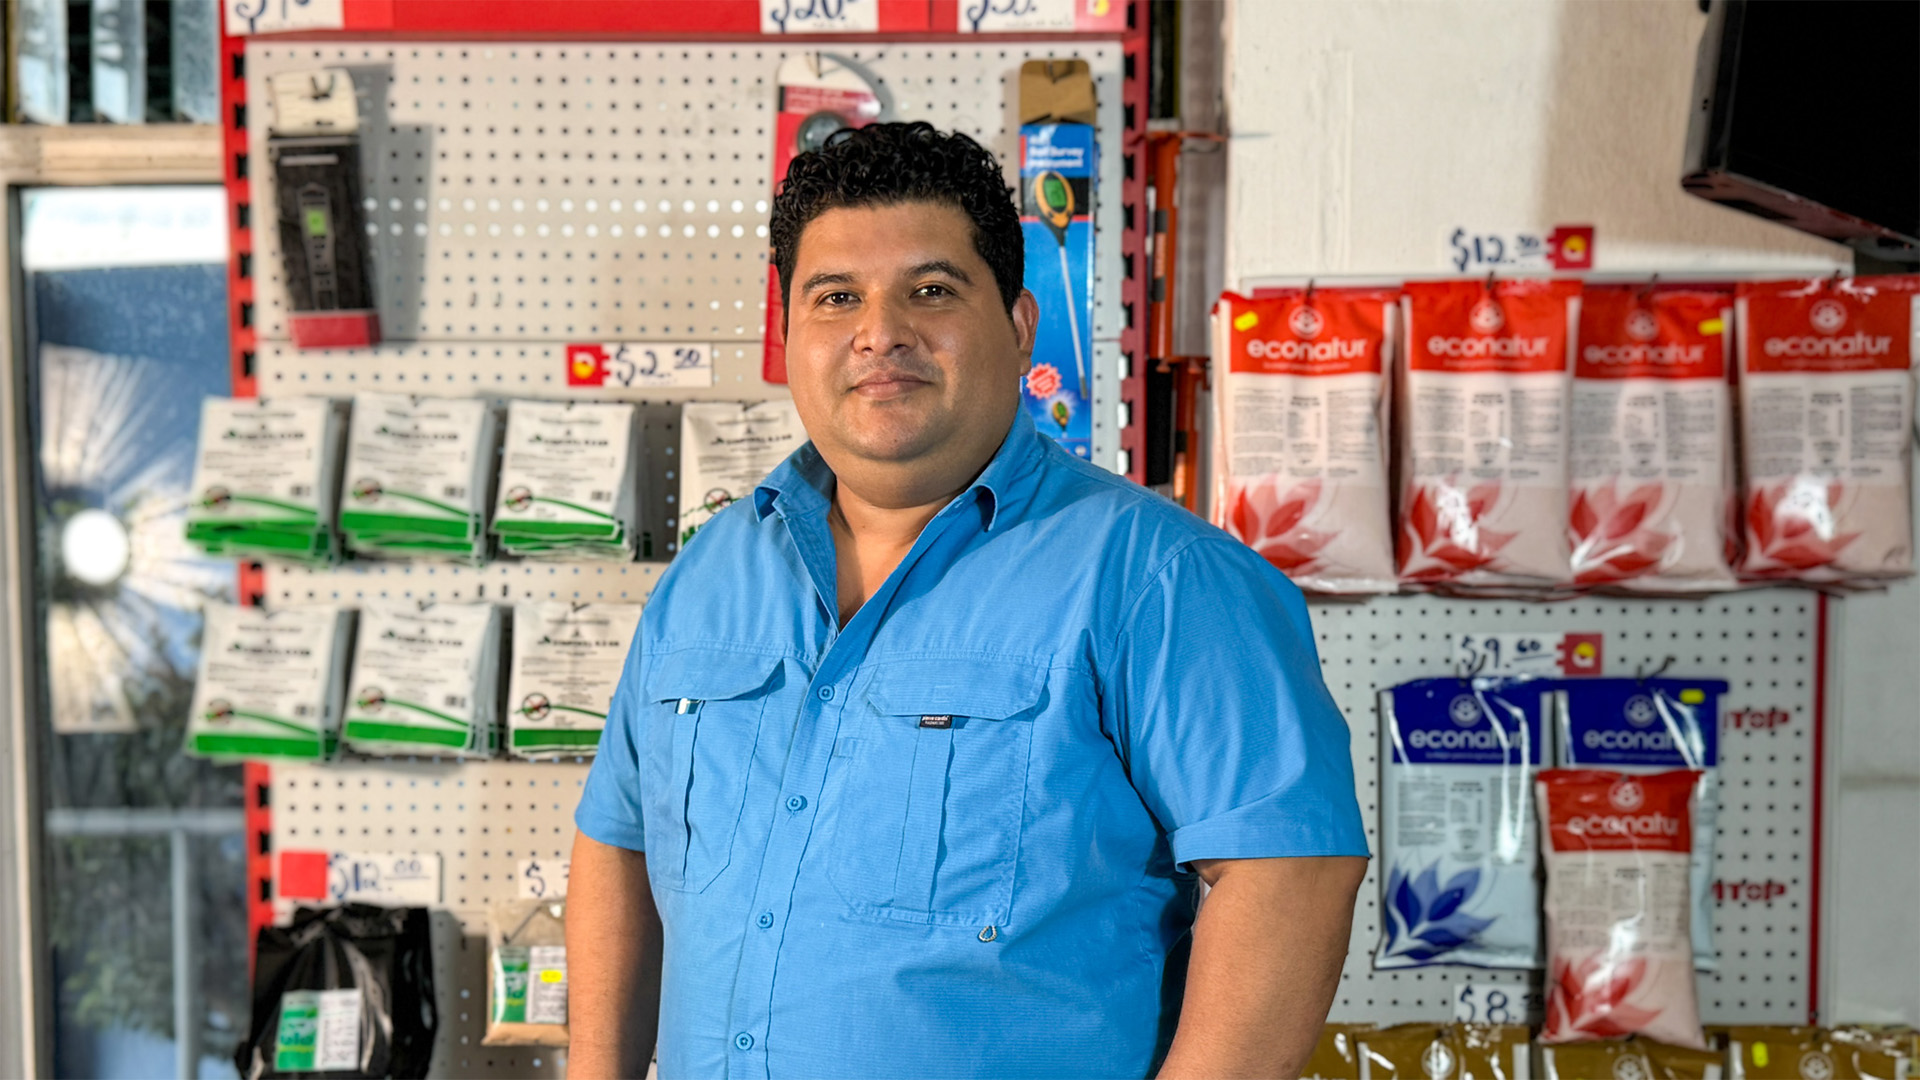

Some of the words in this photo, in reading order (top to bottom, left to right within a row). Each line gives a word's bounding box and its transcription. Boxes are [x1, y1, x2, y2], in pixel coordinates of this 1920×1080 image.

[1247, 337, 1367, 361] econatur
[1427, 334, 1549, 361] econatur
[1583, 342, 1704, 364] econatur
[1764, 331, 1892, 357] econatur
[1723, 711, 1790, 729] TOP
[1567, 812, 1679, 836] econatu
